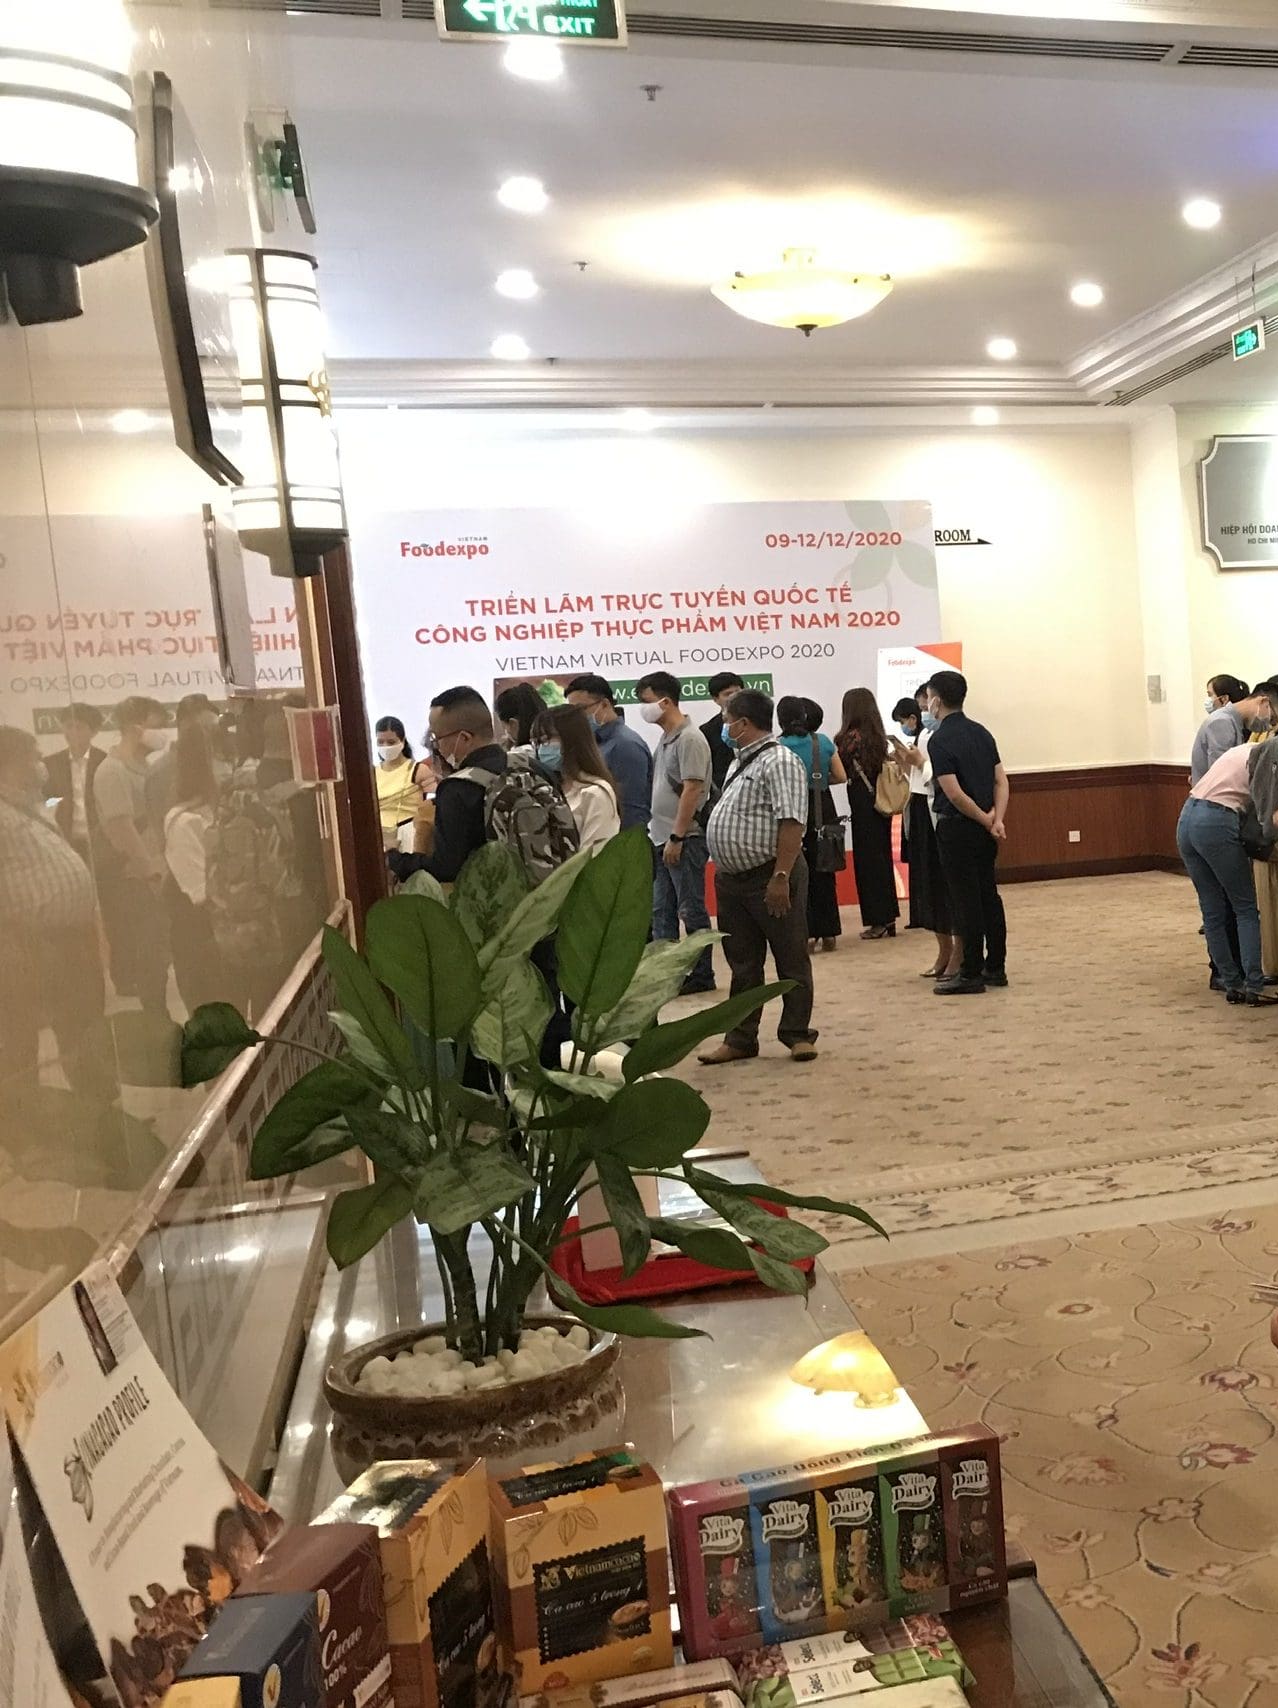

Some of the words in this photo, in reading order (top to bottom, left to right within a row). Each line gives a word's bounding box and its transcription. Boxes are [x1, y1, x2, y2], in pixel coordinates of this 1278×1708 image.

[543, 14, 595, 35] EXIT
[765, 530, 903, 550] 09-12/12/2020
[934, 529, 971, 542] ROOM
[400, 541, 489, 560] Foodexpo
[465, 590, 536, 616] TRIỂN
[544, 593, 594, 614] LÃM
[601, 593, 663, 614] TRỰC
[670, 584, 747, 608] TUYẾN
[753, 583, 820, 606] QUỐC
[826, 581, 853, 603] TẾ
[415, 625, 487, 645] CÔNG
[495, 619, 584, 642] NGHIỆP
[591, 619, 654, 639] THỰC
[662, 609, 727, 634] PHẨM
[734, 612, 783, 634] VIỆT
[791, 613, 840, 630] NAM
[847, 610, 900, 628] 2020
[496, 654, 585, 671] VIETNAM
[591, 650, 673, 668] VIRTUAL
[680, 645, 785, 664] FOODEXPO
[791, 643, 836, 659] 2020
[963, 1462, 987, 1473] Vita
[901, 1475, 925, 1487] Vita
[954, 1471, 987, 1487] Dair
[838, 1490, 862, 1502] Vita
[894, 1484, 933, 1500] Dairy
[773, 1502, 797, 1513] Vita
[830, 1500, 870, 1516] Dairy
[707, 1517, 731, 1529] Vita
[765, 1512, 804, 1529] Dairy
[700, 1526, 740, 1543] Dairy
